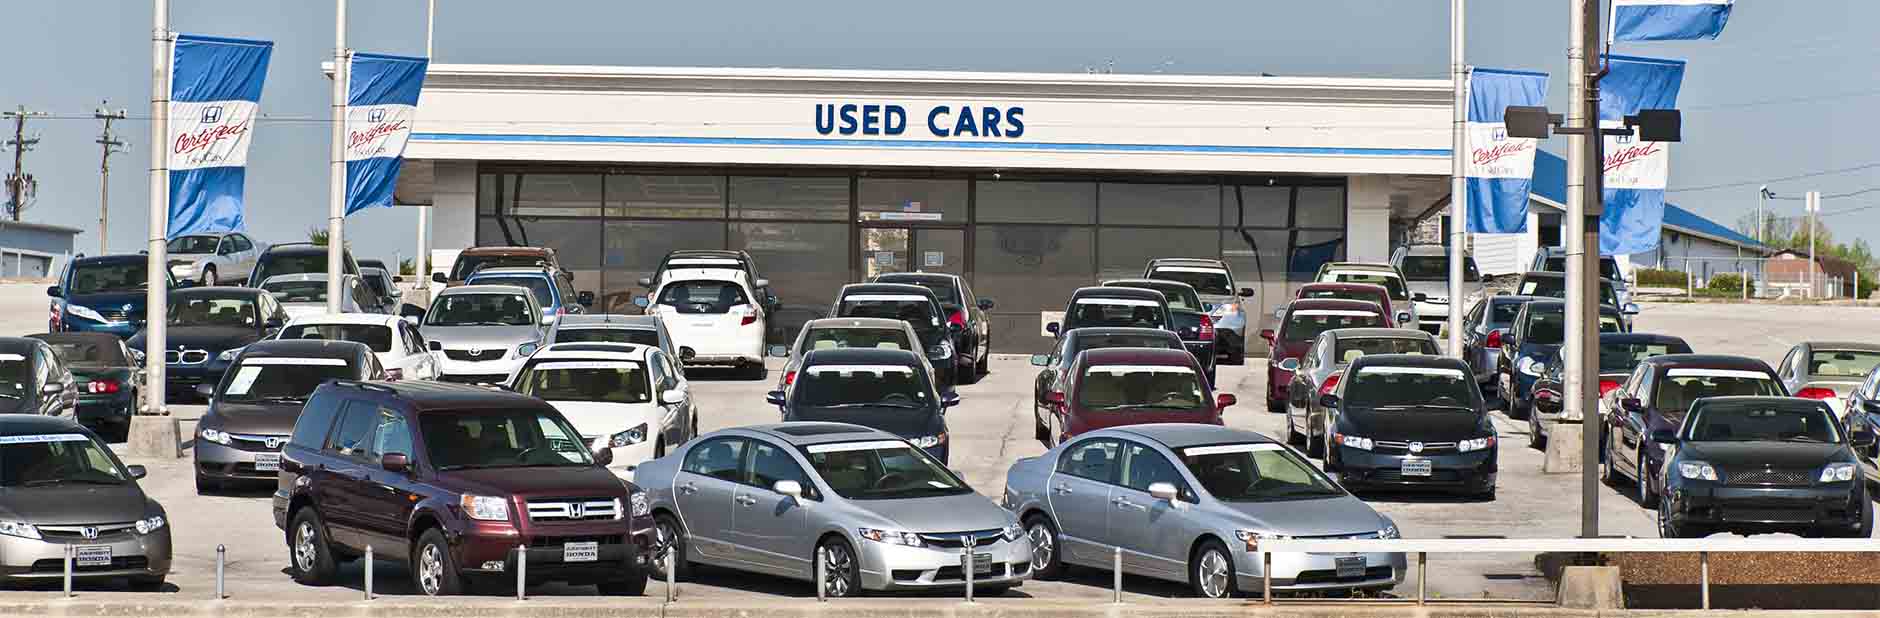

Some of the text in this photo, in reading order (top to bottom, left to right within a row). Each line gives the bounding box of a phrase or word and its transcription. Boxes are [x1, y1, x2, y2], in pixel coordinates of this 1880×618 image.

[349, 120, 408, 147] Certified
[815, 104, 1025, 138] USED CARS
[174, 121, 248, 153] Certified
[1472, 139, 1533, 165] Certified
